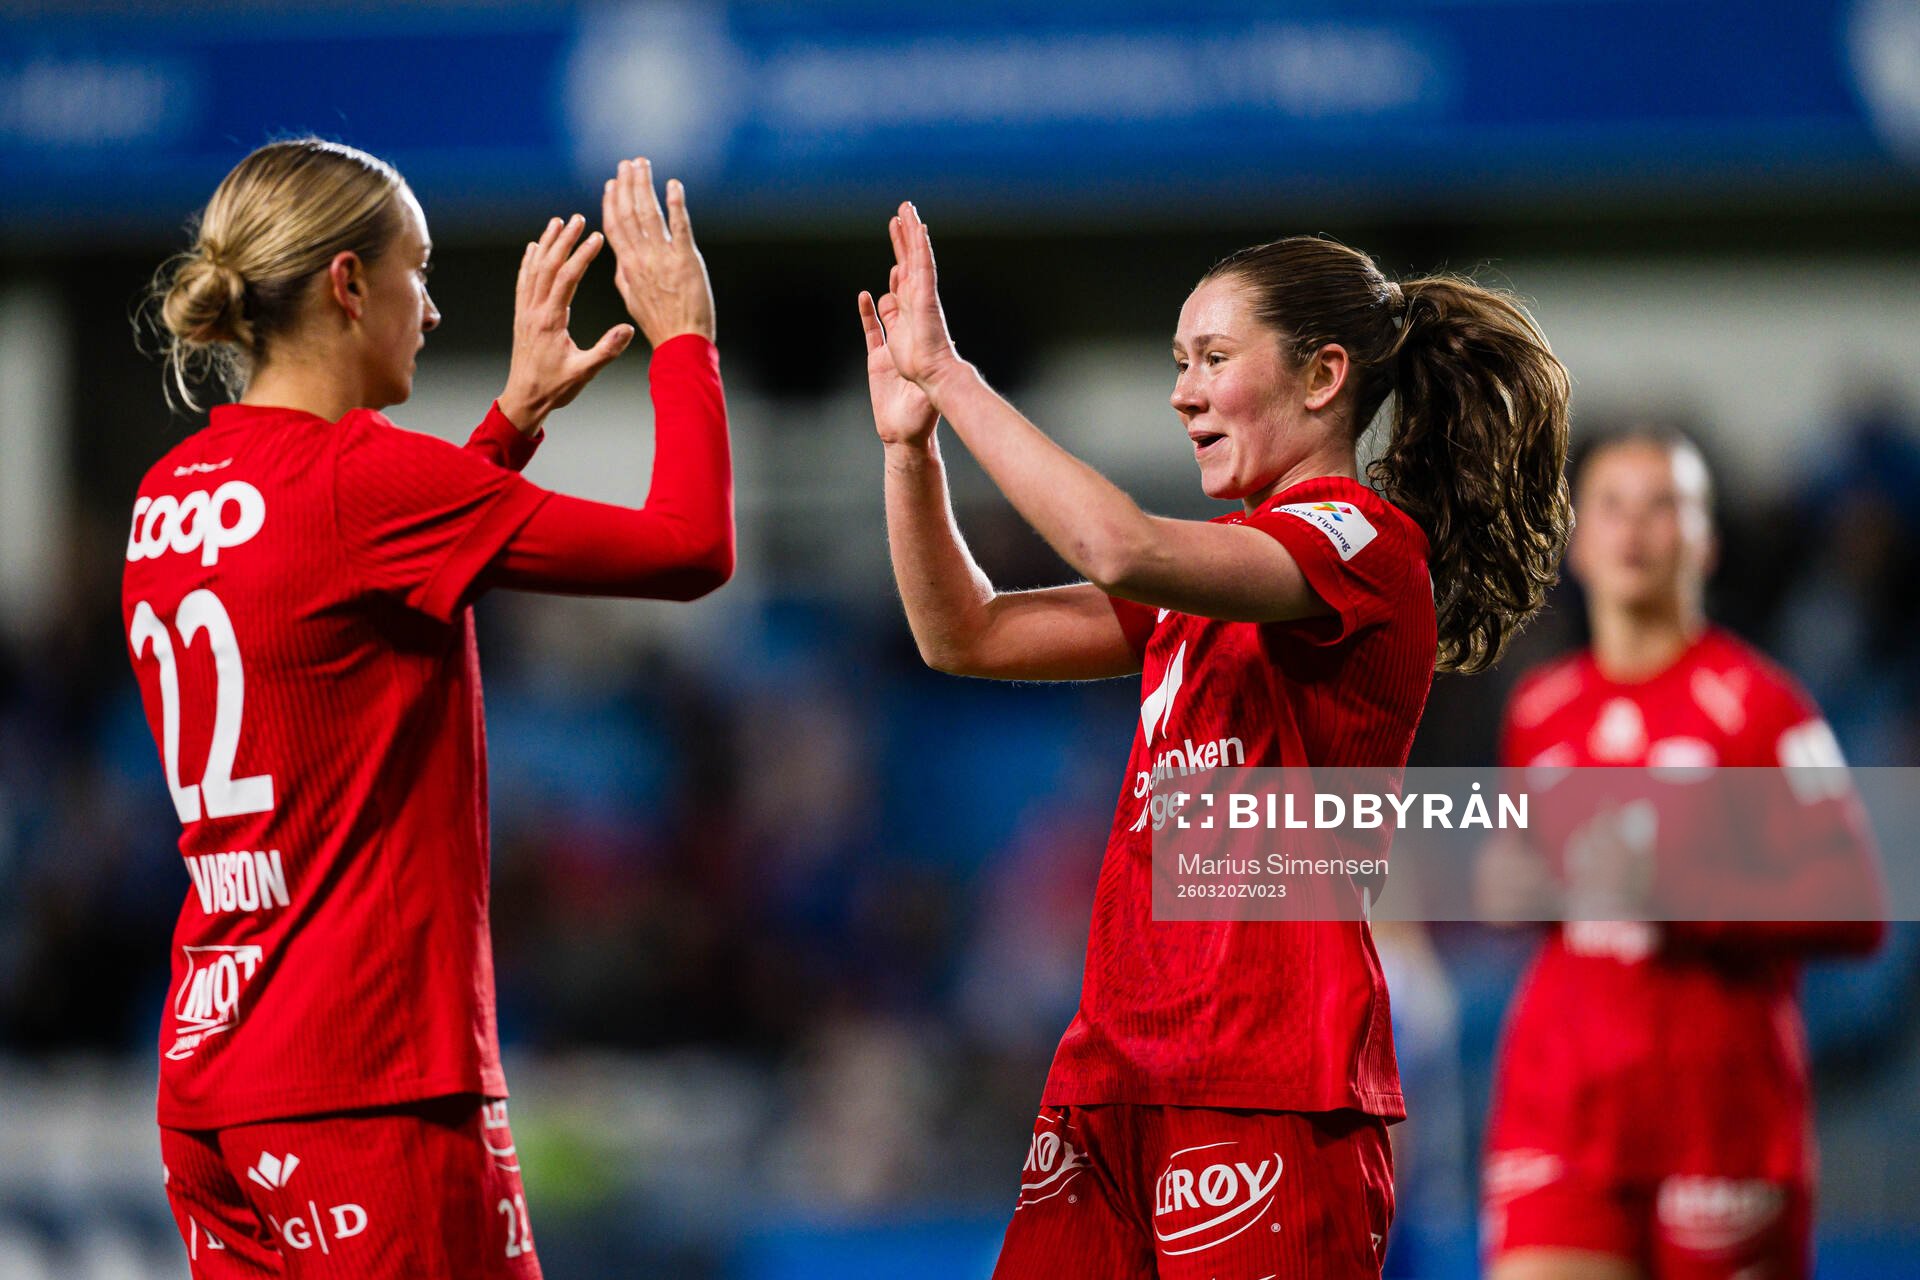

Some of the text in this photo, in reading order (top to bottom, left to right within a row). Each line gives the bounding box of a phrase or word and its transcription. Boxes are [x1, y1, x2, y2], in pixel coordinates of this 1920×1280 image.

[1279, 507, 1351, 553] Norsk Tipping
[130, 588, 275, 824] 22
[1155, 1160, 1270, 1216] LERØY
